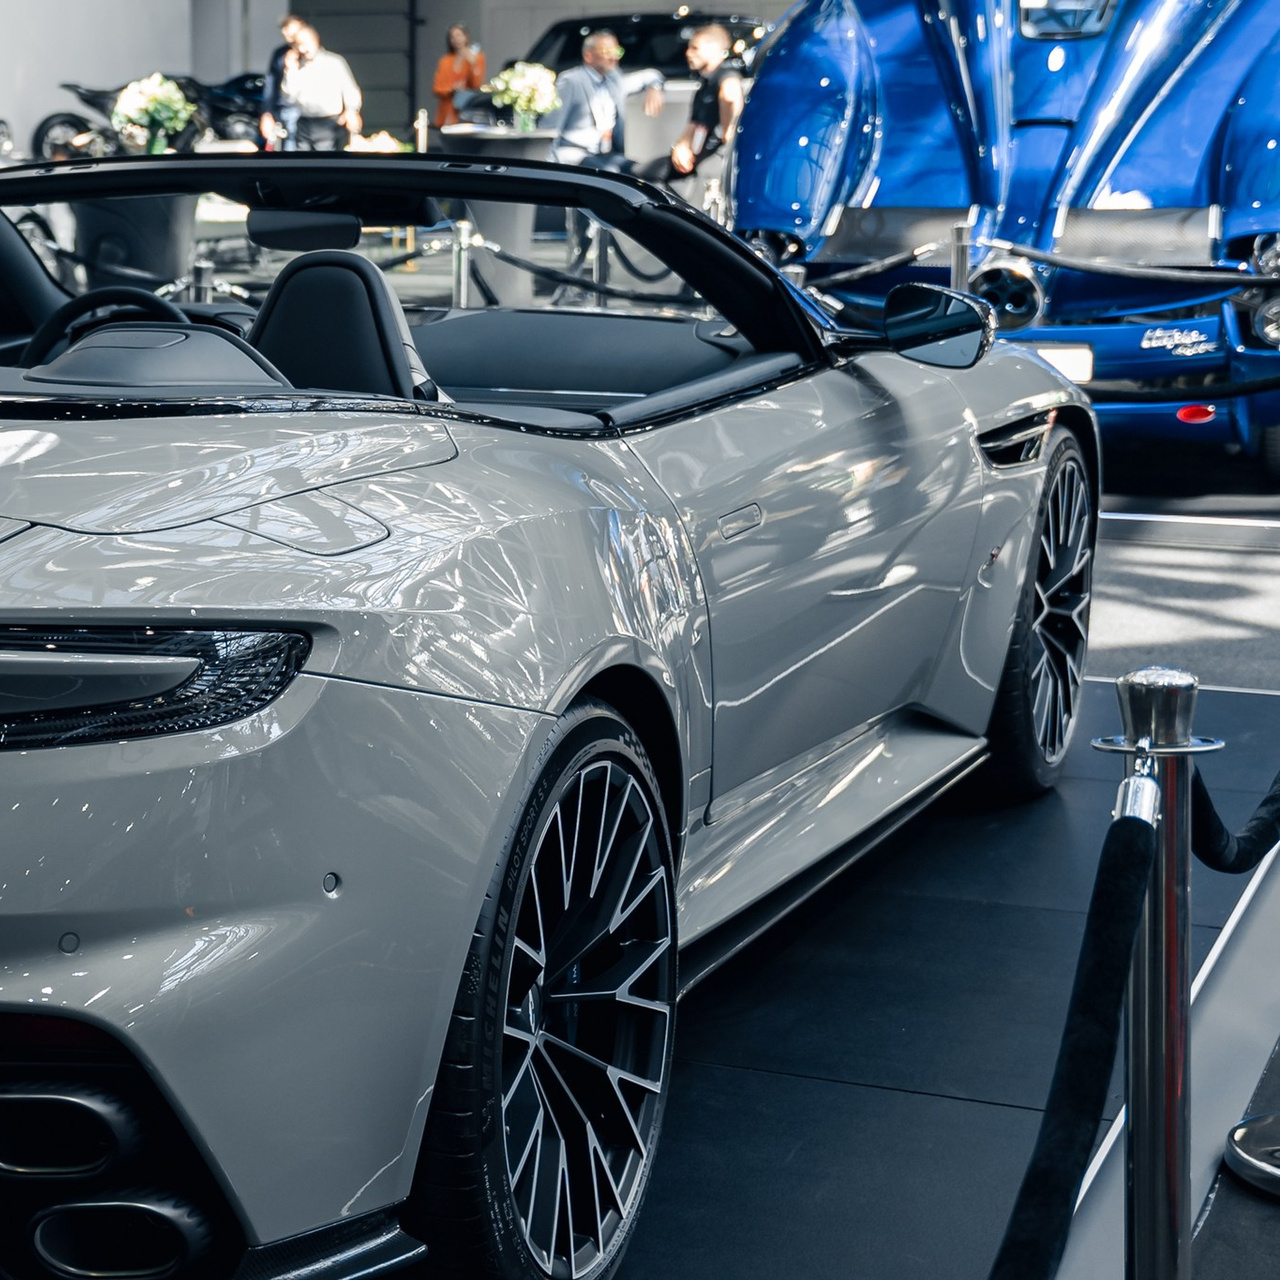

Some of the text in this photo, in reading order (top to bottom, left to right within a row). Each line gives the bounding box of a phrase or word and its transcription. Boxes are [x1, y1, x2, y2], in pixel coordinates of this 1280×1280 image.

[482, 905, 510, 1091] MICHELIN
[507, 844, 523, 892] PILOT
[521, 799, 538, 846] SPORT
